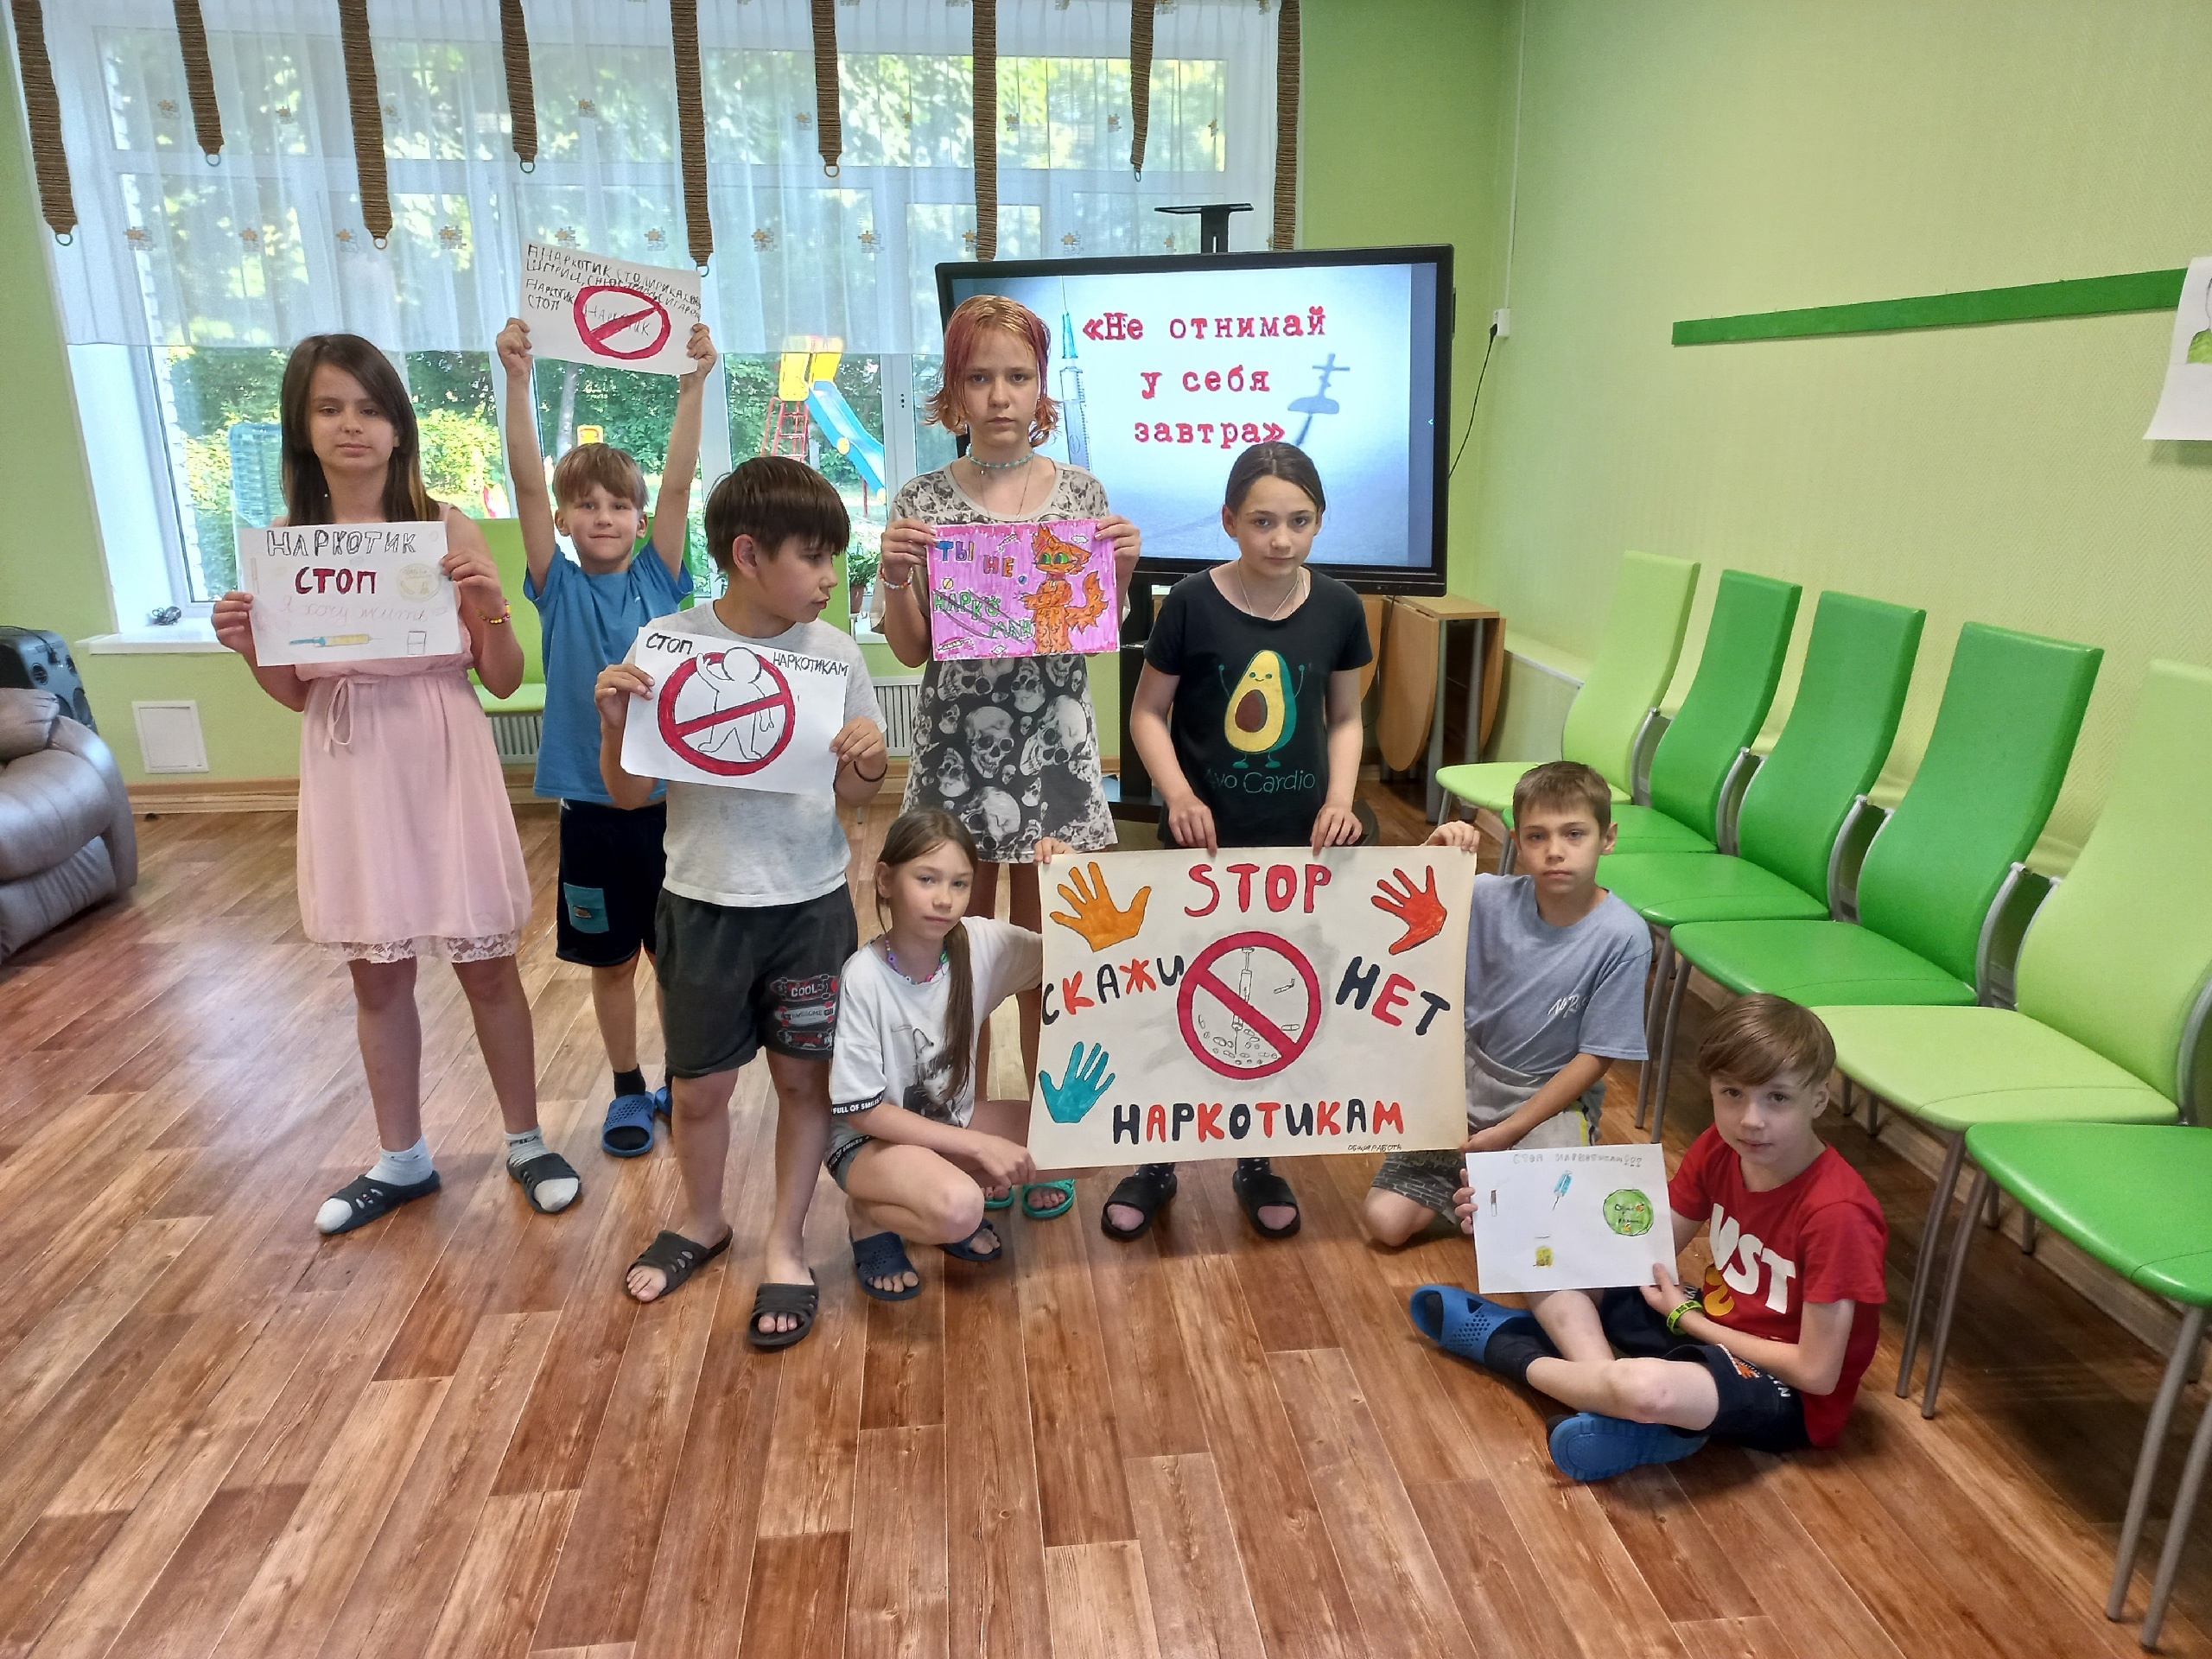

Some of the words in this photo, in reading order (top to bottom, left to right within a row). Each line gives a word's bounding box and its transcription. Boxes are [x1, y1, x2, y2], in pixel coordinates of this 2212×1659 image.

[528, 294, 560, 311] СТОП
[1083, 312, 1144, 341] «Не
[1169, 306, 1327, 340] отнимай
[1141, 370, 1162, 399] у
[1182, 365, 1270, 393] себя
[1135, 422, 1286, 448] завтра»
[266, 529, 416, 557] НАРКОТИК
[935, 540, 975, 562] ТЫ
[983, 555, 1014, 578] НЕ
[295, 566, 378, 594] СТОП
[645, 632, 693, 655] СТОП
[772, 652, 849, 677] НАРКОТИКАМ
[1243, 770, 1316, 794] Cardio
[1184, 863, 1332, 917] STOP
[791, 983, 818, 997] COOL
[1042, 955, 1185, 1026] СКАЖИ
[1335, 956, 1451, 1036] НЕТ
[832, 1106, 849, 1115] FULL
[849, 1103, 860, 1112] OF
[1112, 1098, 1404, 1145] НАРКОТИКАМ
[1513, 1154, 1543, 1164] СТОП
